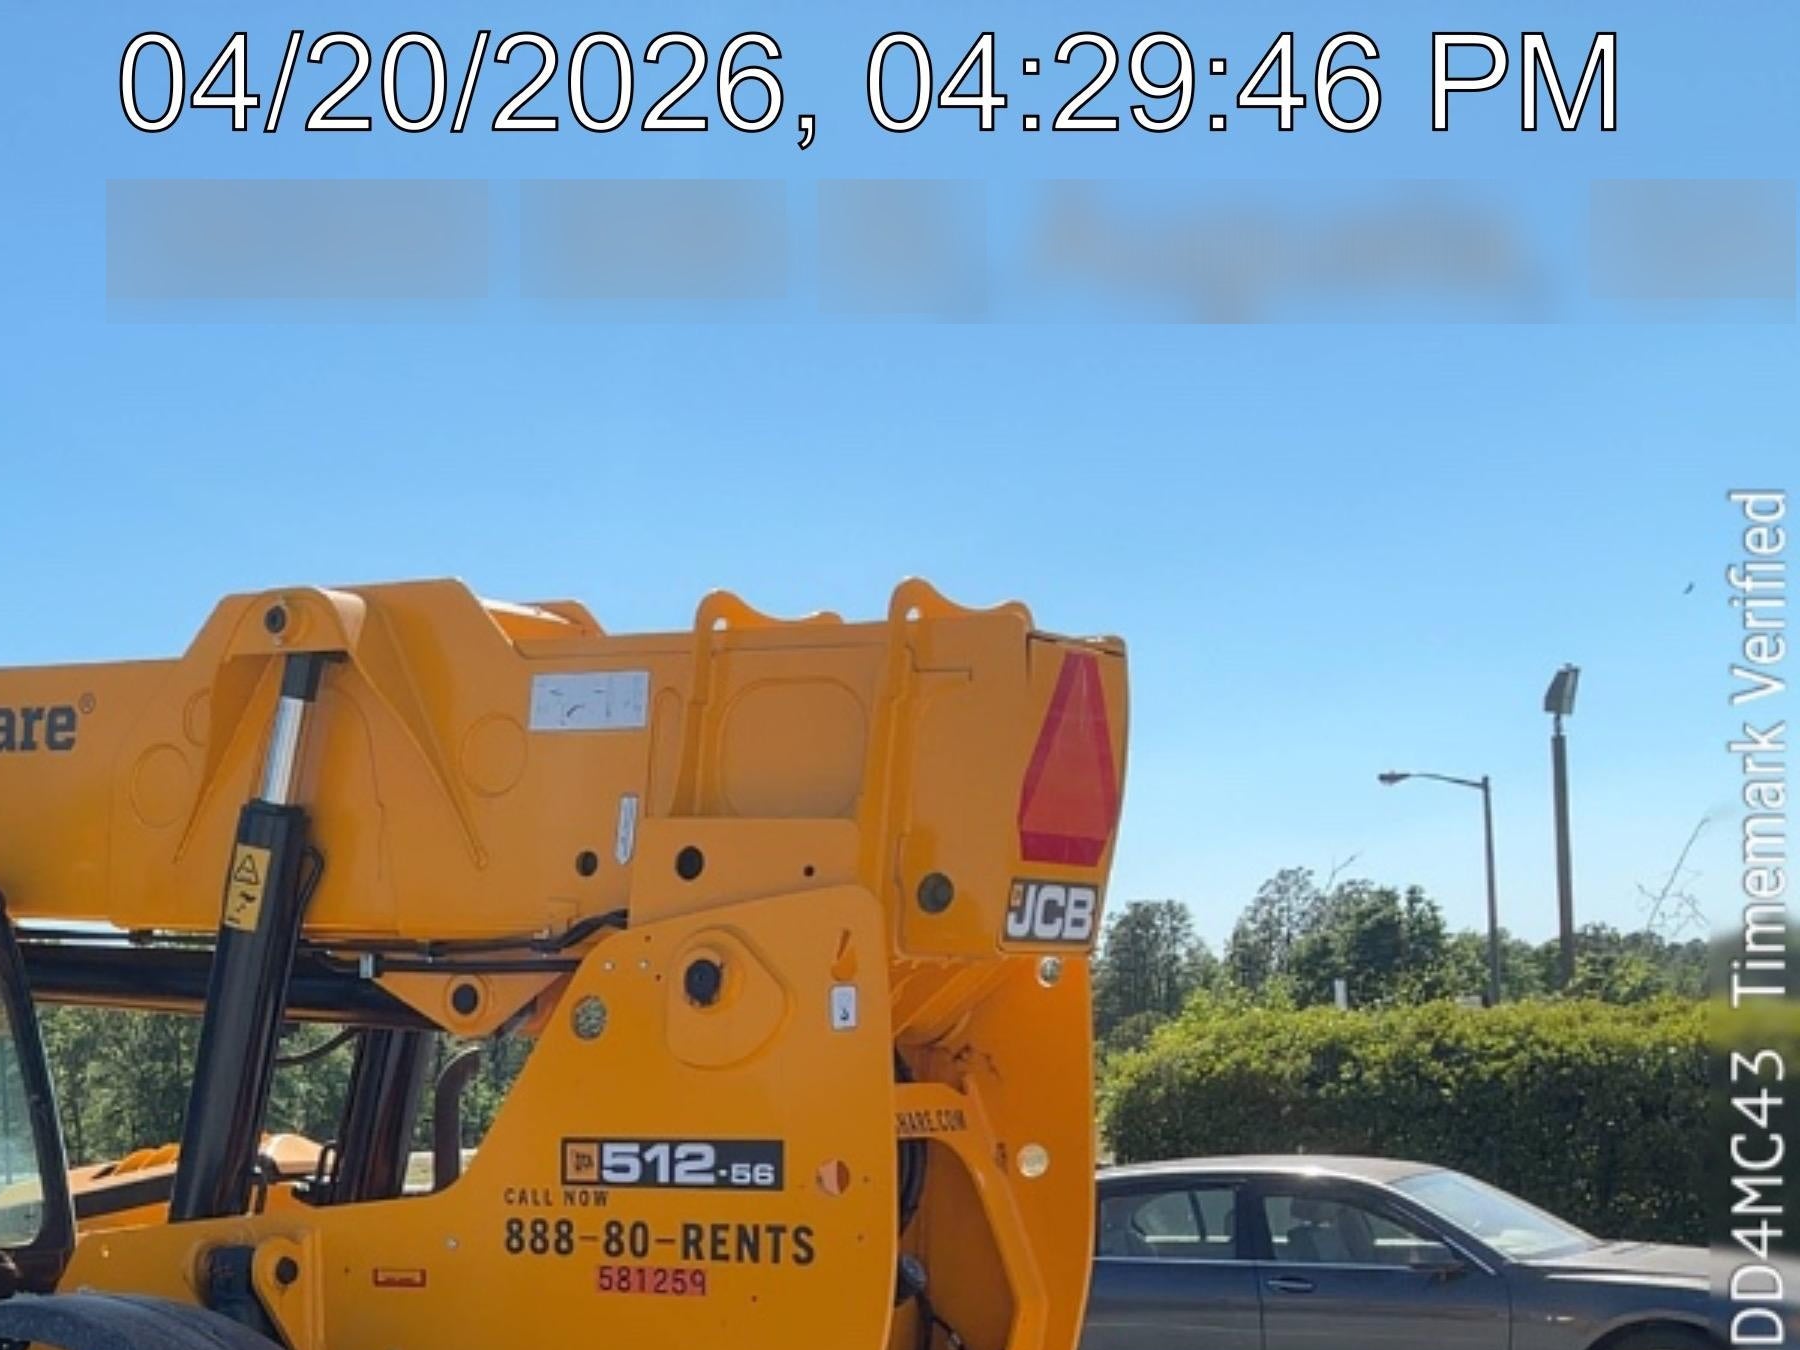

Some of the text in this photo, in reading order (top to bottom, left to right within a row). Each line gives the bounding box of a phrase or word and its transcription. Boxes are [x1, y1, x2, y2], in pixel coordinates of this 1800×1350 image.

[1006, 884, 1096, 940] JCB
[504, 1188, 609, 1207] CALL NOW
[504, 1218, 816, 1265] 888-80-RENTS
[598, 1265, 706, 1296] 581259
